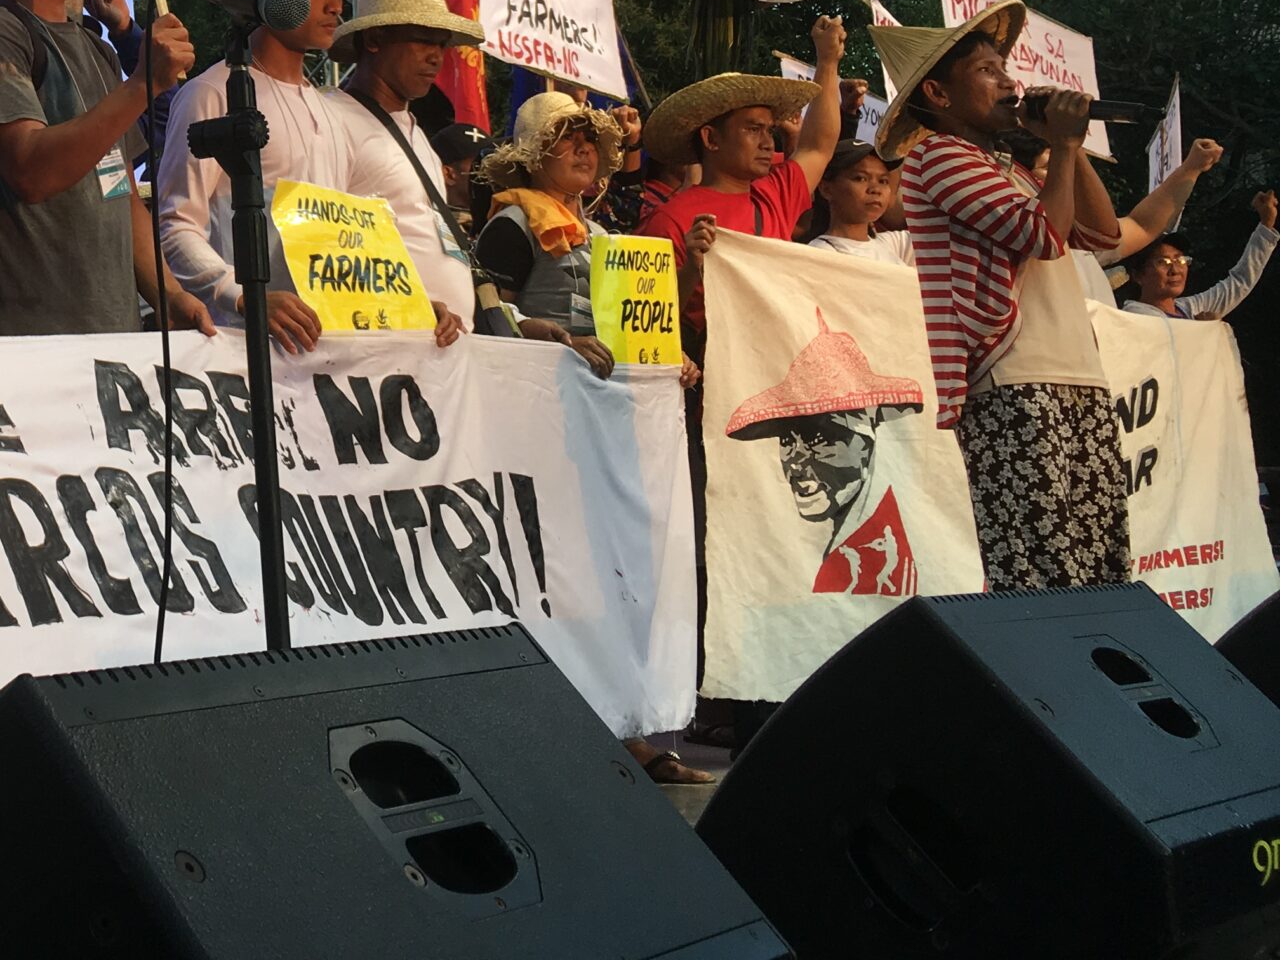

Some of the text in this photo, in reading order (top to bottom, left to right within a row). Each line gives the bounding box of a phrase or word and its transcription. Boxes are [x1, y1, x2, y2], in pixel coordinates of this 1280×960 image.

[1044, 32, 1067, 64] SA
[296, 197, 376, 231] HANDS-OFF
[337, 229, 365, 250] OUR
[308, 253, 413, 297] FARMERS
[604, 248, 672, 275] HANDS-OFF
[635, 276, 657, 295] OUR
[620, 297, 675, 335] PEOPLE
[312, 372, 441, 466] NO
[236, 471, 552, 627] COUNTRY!
[1137, 539, 1225, 576] FARMERS!
